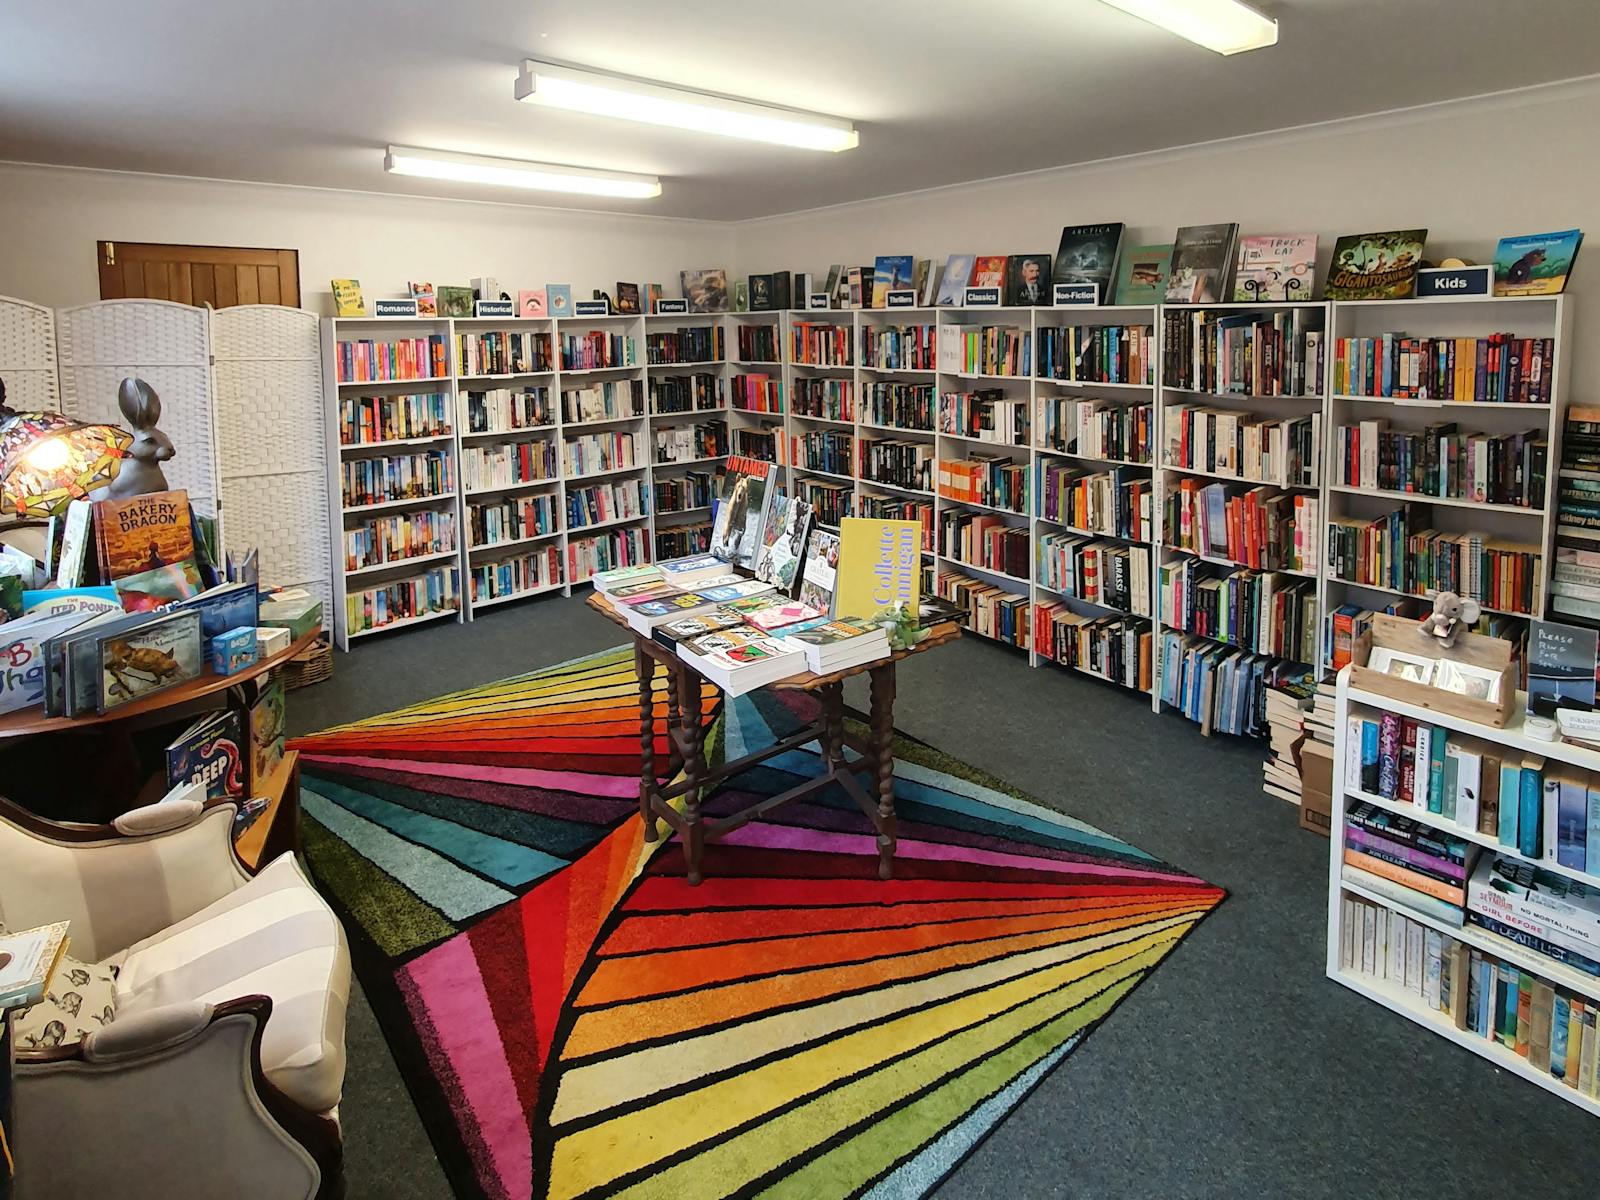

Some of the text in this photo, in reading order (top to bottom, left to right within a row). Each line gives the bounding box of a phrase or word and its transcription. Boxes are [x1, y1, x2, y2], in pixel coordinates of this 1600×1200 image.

[1071, 227, 1111, 235] ARCTICA
[1270, 239, 1305, 248] TRUCK
[1434, 277, 1467, 289] Kids
[967, 292, 997, 301] Classics
[1055, 291, 1095, 300] Non-Fiction
[377, 305, 415, 313] Romance
[480, 305, 512, 313] Historical
[661, 303, 684, 311] Fantasy
[726, 455, 769, 478] UNTAMED
[137, 497, 156, 506] THE
[118, 503, 177, 522] BAKERY
[119, 514, 177, 533] DRAGON
[872, 526, 894, 605] Collette
[898, 528, 915, 605] innigan
[1114, 556, 1123, 592] BARASSI
[1538, 629, 1574, 644] PLEASE
[1538, 641, 1567, 653] RING
[1539, 650, 1558, 660] FOR
[1538, 660, 1573, 672] SERVICE
[191, 755, 228, 786] DEEP
[1382, 853, 1407, 868] CLEARY
[1398, 875, 1439, 894] DAUGHTER
[1480, 892, 1513, 911] SEYMOUR
[1482, 905, 1543, 934] GIRL BEFORE
[1520, 907, 1590, 938] NO MORTAL THING
[1500, 926, 1538, 948] DEATH
[1540, 942, 1567, 960] LIST
